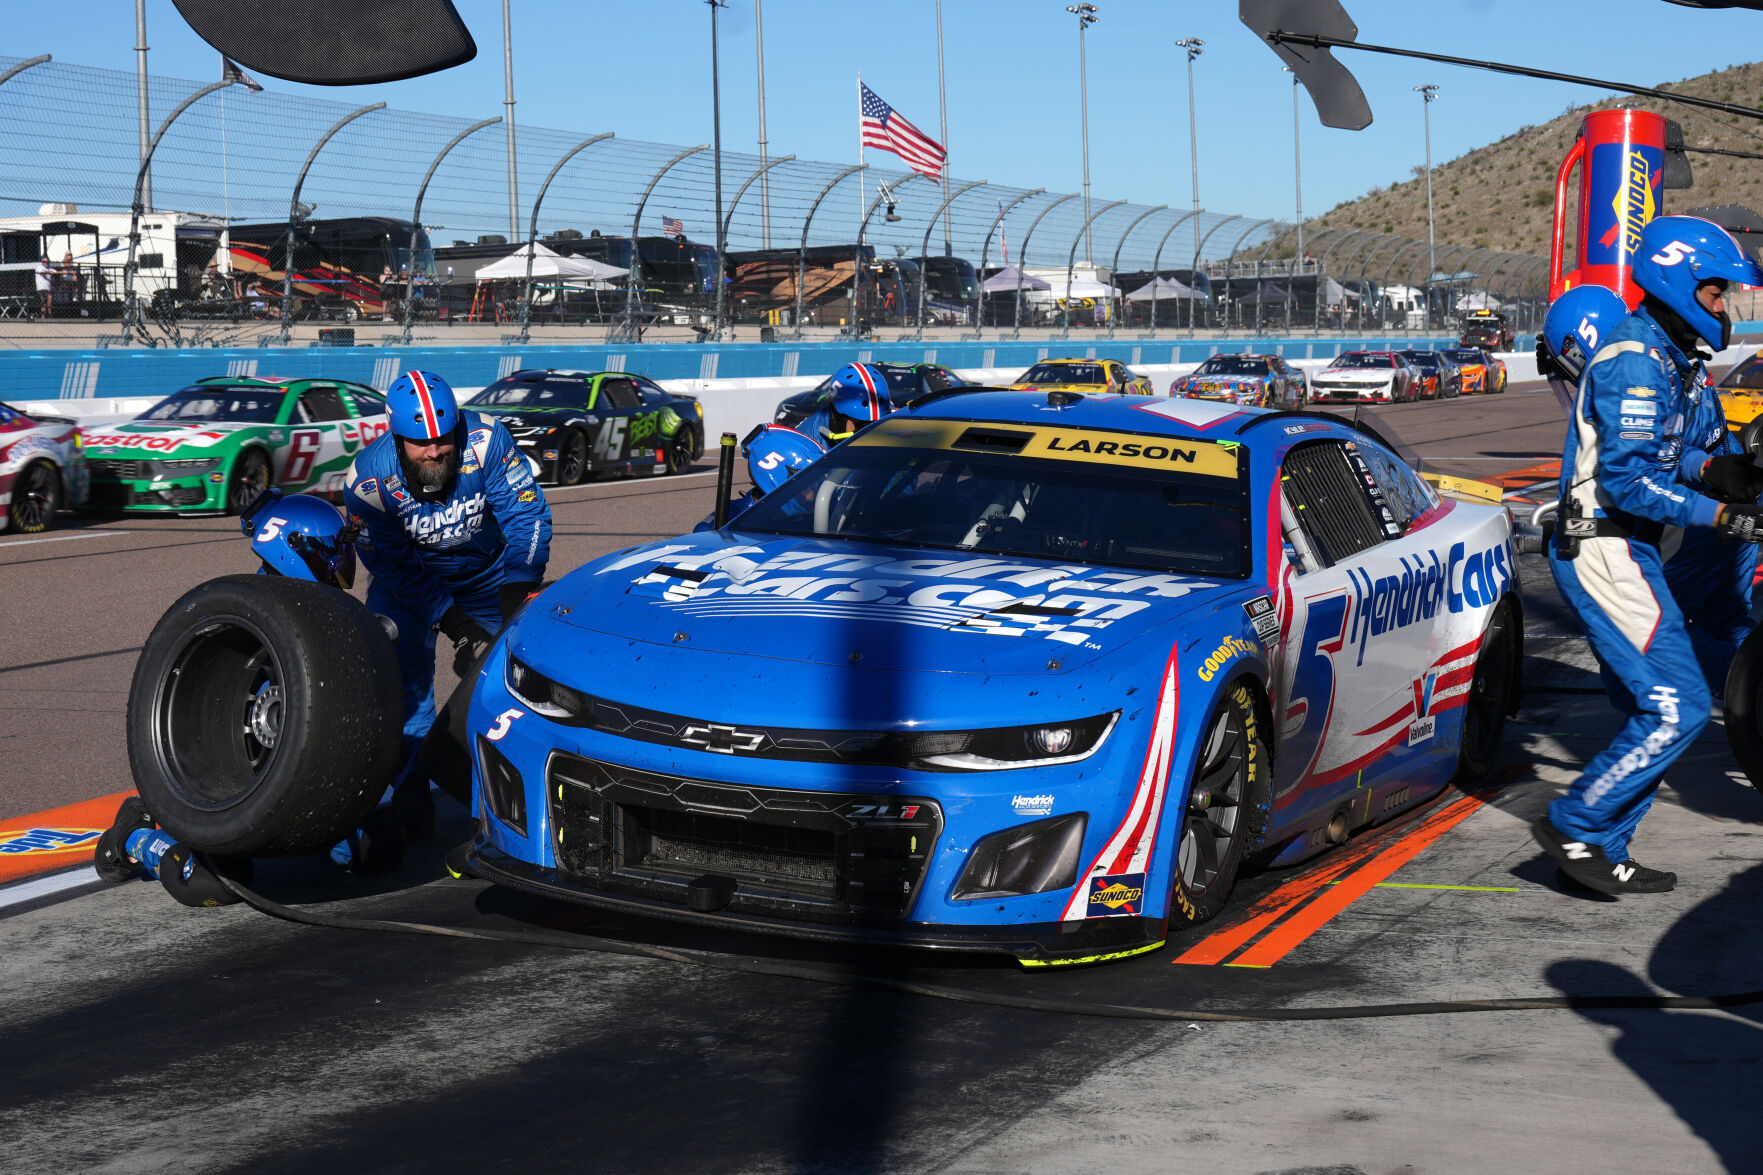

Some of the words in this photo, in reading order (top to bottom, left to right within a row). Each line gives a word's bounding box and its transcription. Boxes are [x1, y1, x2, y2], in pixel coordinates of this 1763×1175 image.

[1625, 153, 1648, 252] SUNOCO
[1651, 240, 1697, 266] 5
[1577, 316, 1599, 350] 5
[83, 432, 188, 451] astrol
[595, 416, 629, 460] 45
[1283, 425, 1307, 437] KYLE
[283, 430, 322, 484] 6
[757, 451, 787, 471] 5
[1046, 437, 1197, 463] LARSON
[404, 492, 487, 538] Hendrick
[256, 516, 290, 543] 5
[416, 513, 484, 545] Cars.cm
[593, 544, 1221, 598] Hendrick
[1346, 549, 1447, 667] Hendrick
[1447, 541, 1518, 613] Cars
[1084, 641, 1101, 650] TM
[1198, 635, 1259, 682] GOODYEAR
[1275, 588, 1351, 800] 5
[486, 707, 527, 742] 5
[1410, 722, 1434, 741] Valvoline
[845, 804, 921, 819] ZL1
[1011, 794, 1055, 808] Hendrick
[0, 828, 103, 853] Tide
[1090, 888, 1143, 904] SUNOCO
